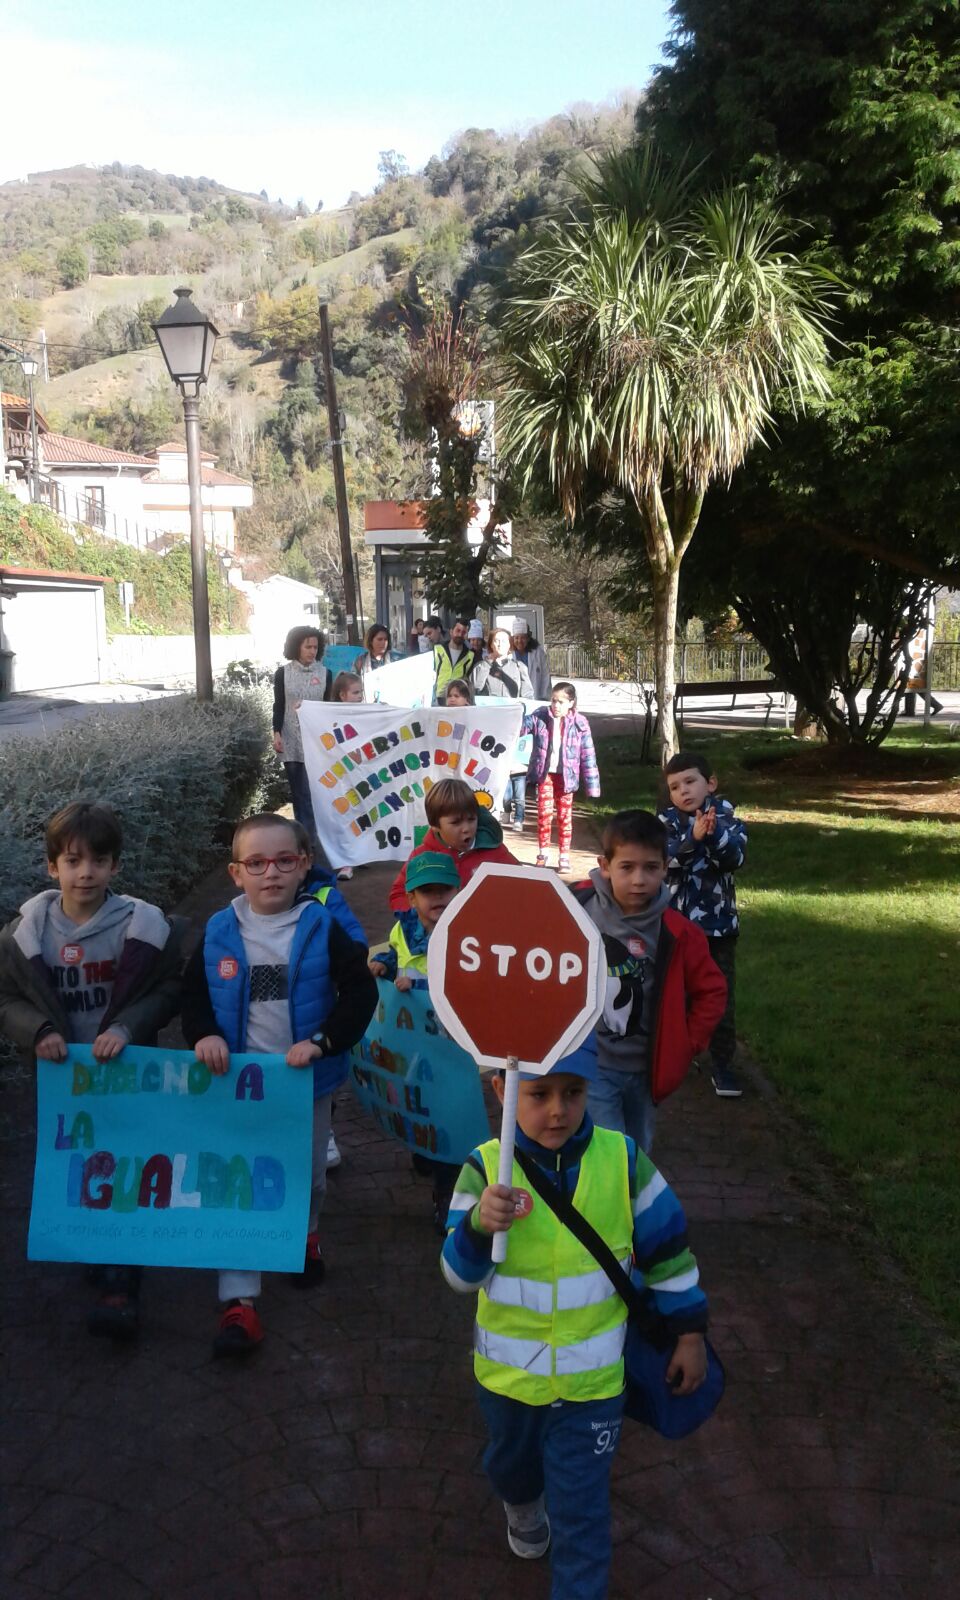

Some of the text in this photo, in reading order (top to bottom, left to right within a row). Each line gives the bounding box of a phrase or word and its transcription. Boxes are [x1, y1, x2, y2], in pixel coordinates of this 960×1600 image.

[319, 722, 359, 751] DÍA
[319, 721, 425, 788] UNIVERSAL
[437, 720, 466, 741] DE
[469, 729, 507, 759] LOS
[332, 749, 492, 815] DERECHOS DE LA
[459, 936, 583, 984] STOP
[235, 1062, 264, 1101] A
[55, 1110, 94, 1150] LA
[66, 1151, 286, 1213] IGUALDAD
